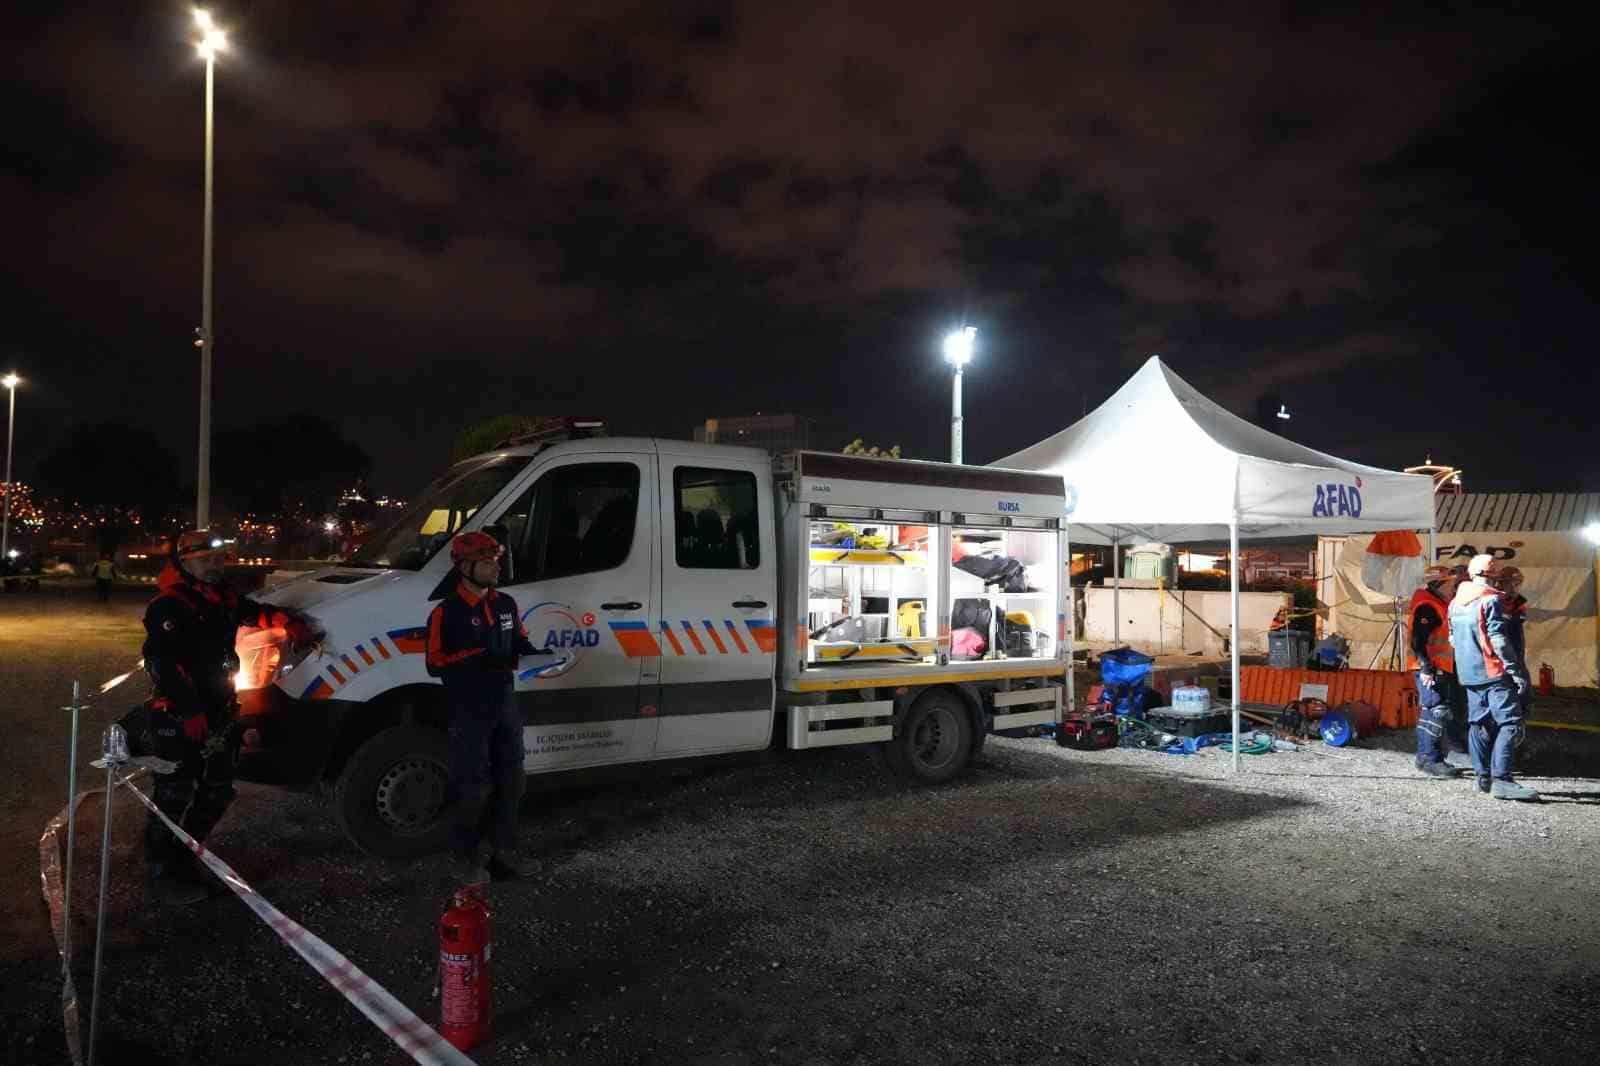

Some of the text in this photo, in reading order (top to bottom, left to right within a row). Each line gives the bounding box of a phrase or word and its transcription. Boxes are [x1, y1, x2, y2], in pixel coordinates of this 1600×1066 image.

[998, 501, 1020, 512] BURSA
[1312, 483, 1362, 518] AFAD
[544, 629, 600, 648] AFAD
